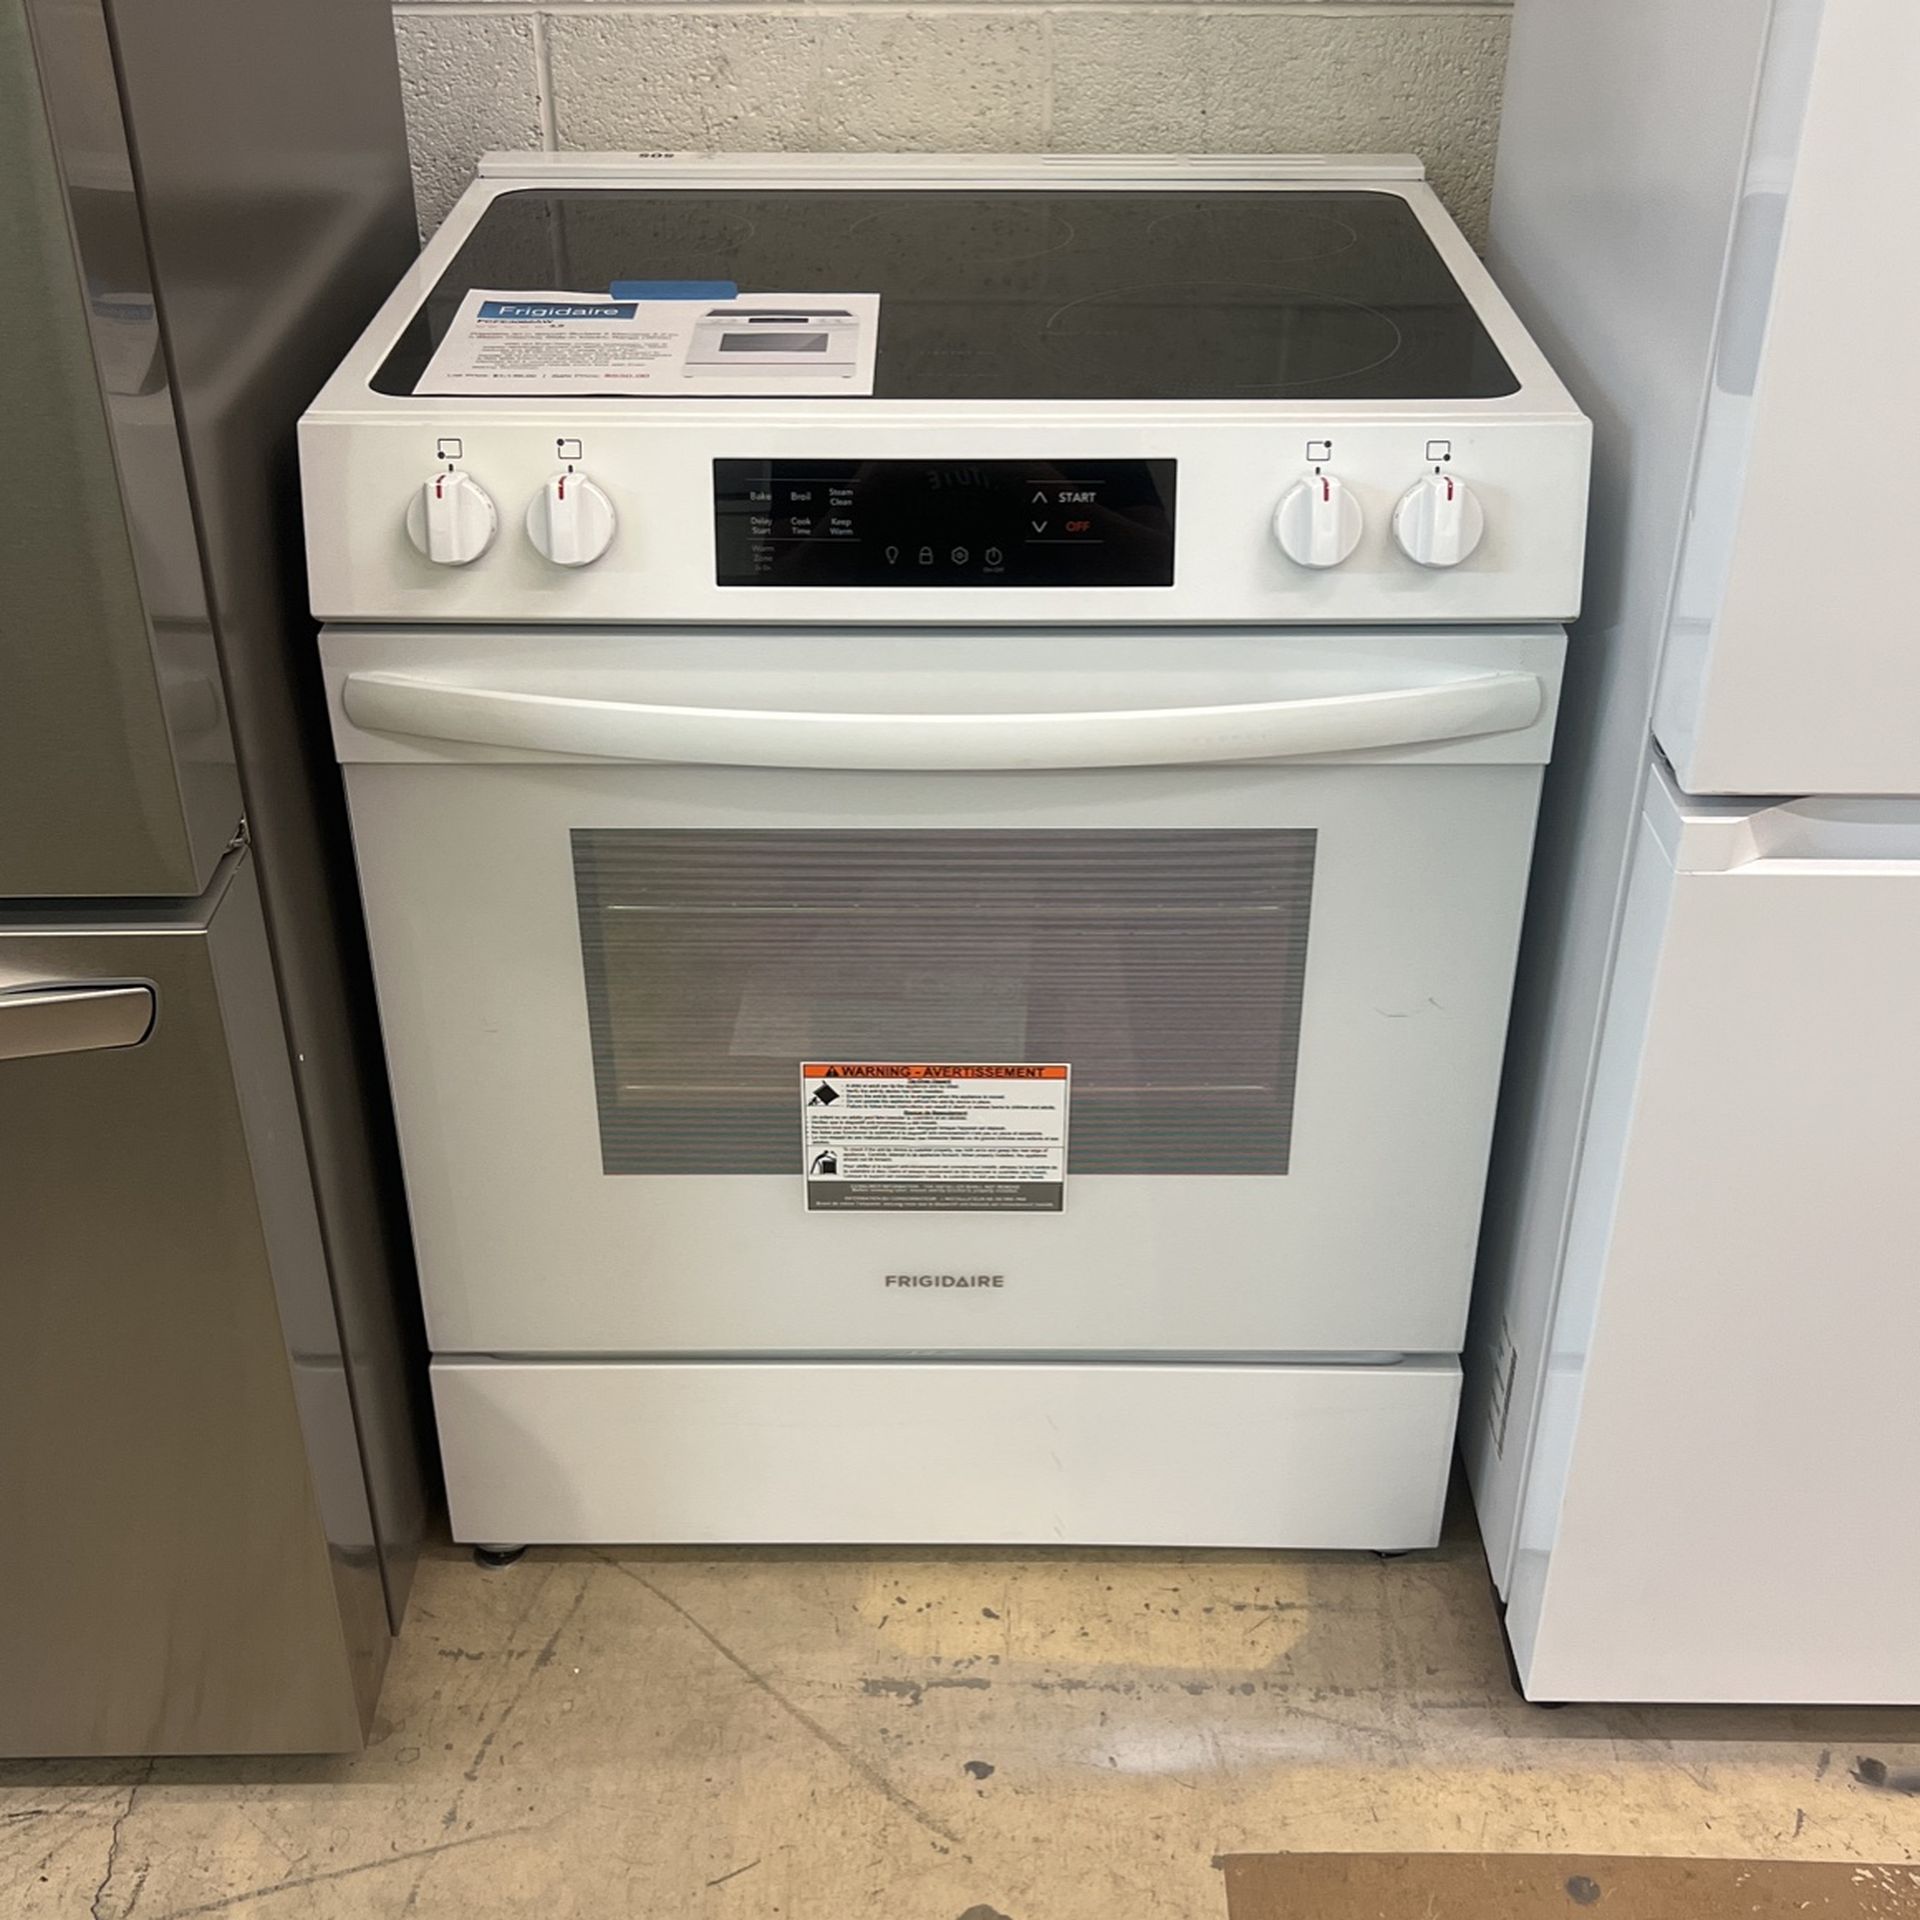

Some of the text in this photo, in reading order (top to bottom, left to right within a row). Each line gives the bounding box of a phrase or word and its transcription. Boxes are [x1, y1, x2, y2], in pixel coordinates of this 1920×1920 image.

[499, 306, 619, 317] Frigidaire
[750, 491, 772, 501] Bake
[790, 491, 812, 501] Broil
[829, 488, 854, 497] Steam
[1057, 492, 1097, 503] START
[829, 498, 853, 506] Clean
[750, 517, 772, 527] Delay
[790, 517, 811, 525] Cook
[831, 518, 852, 527] Keep
[752, 527, 772, 535] Start
[792, 527, 811, 535] Time
[829, 527, 854, 535] Warm
[1065, 521, 1091, 532] OFF
[842, 1066, 911, 1078] WARNING
[923, 1066, 1045, 1078] AVERTISSEMENT
[885, 1275, 1004, 1288] FRIGIDAIRE
